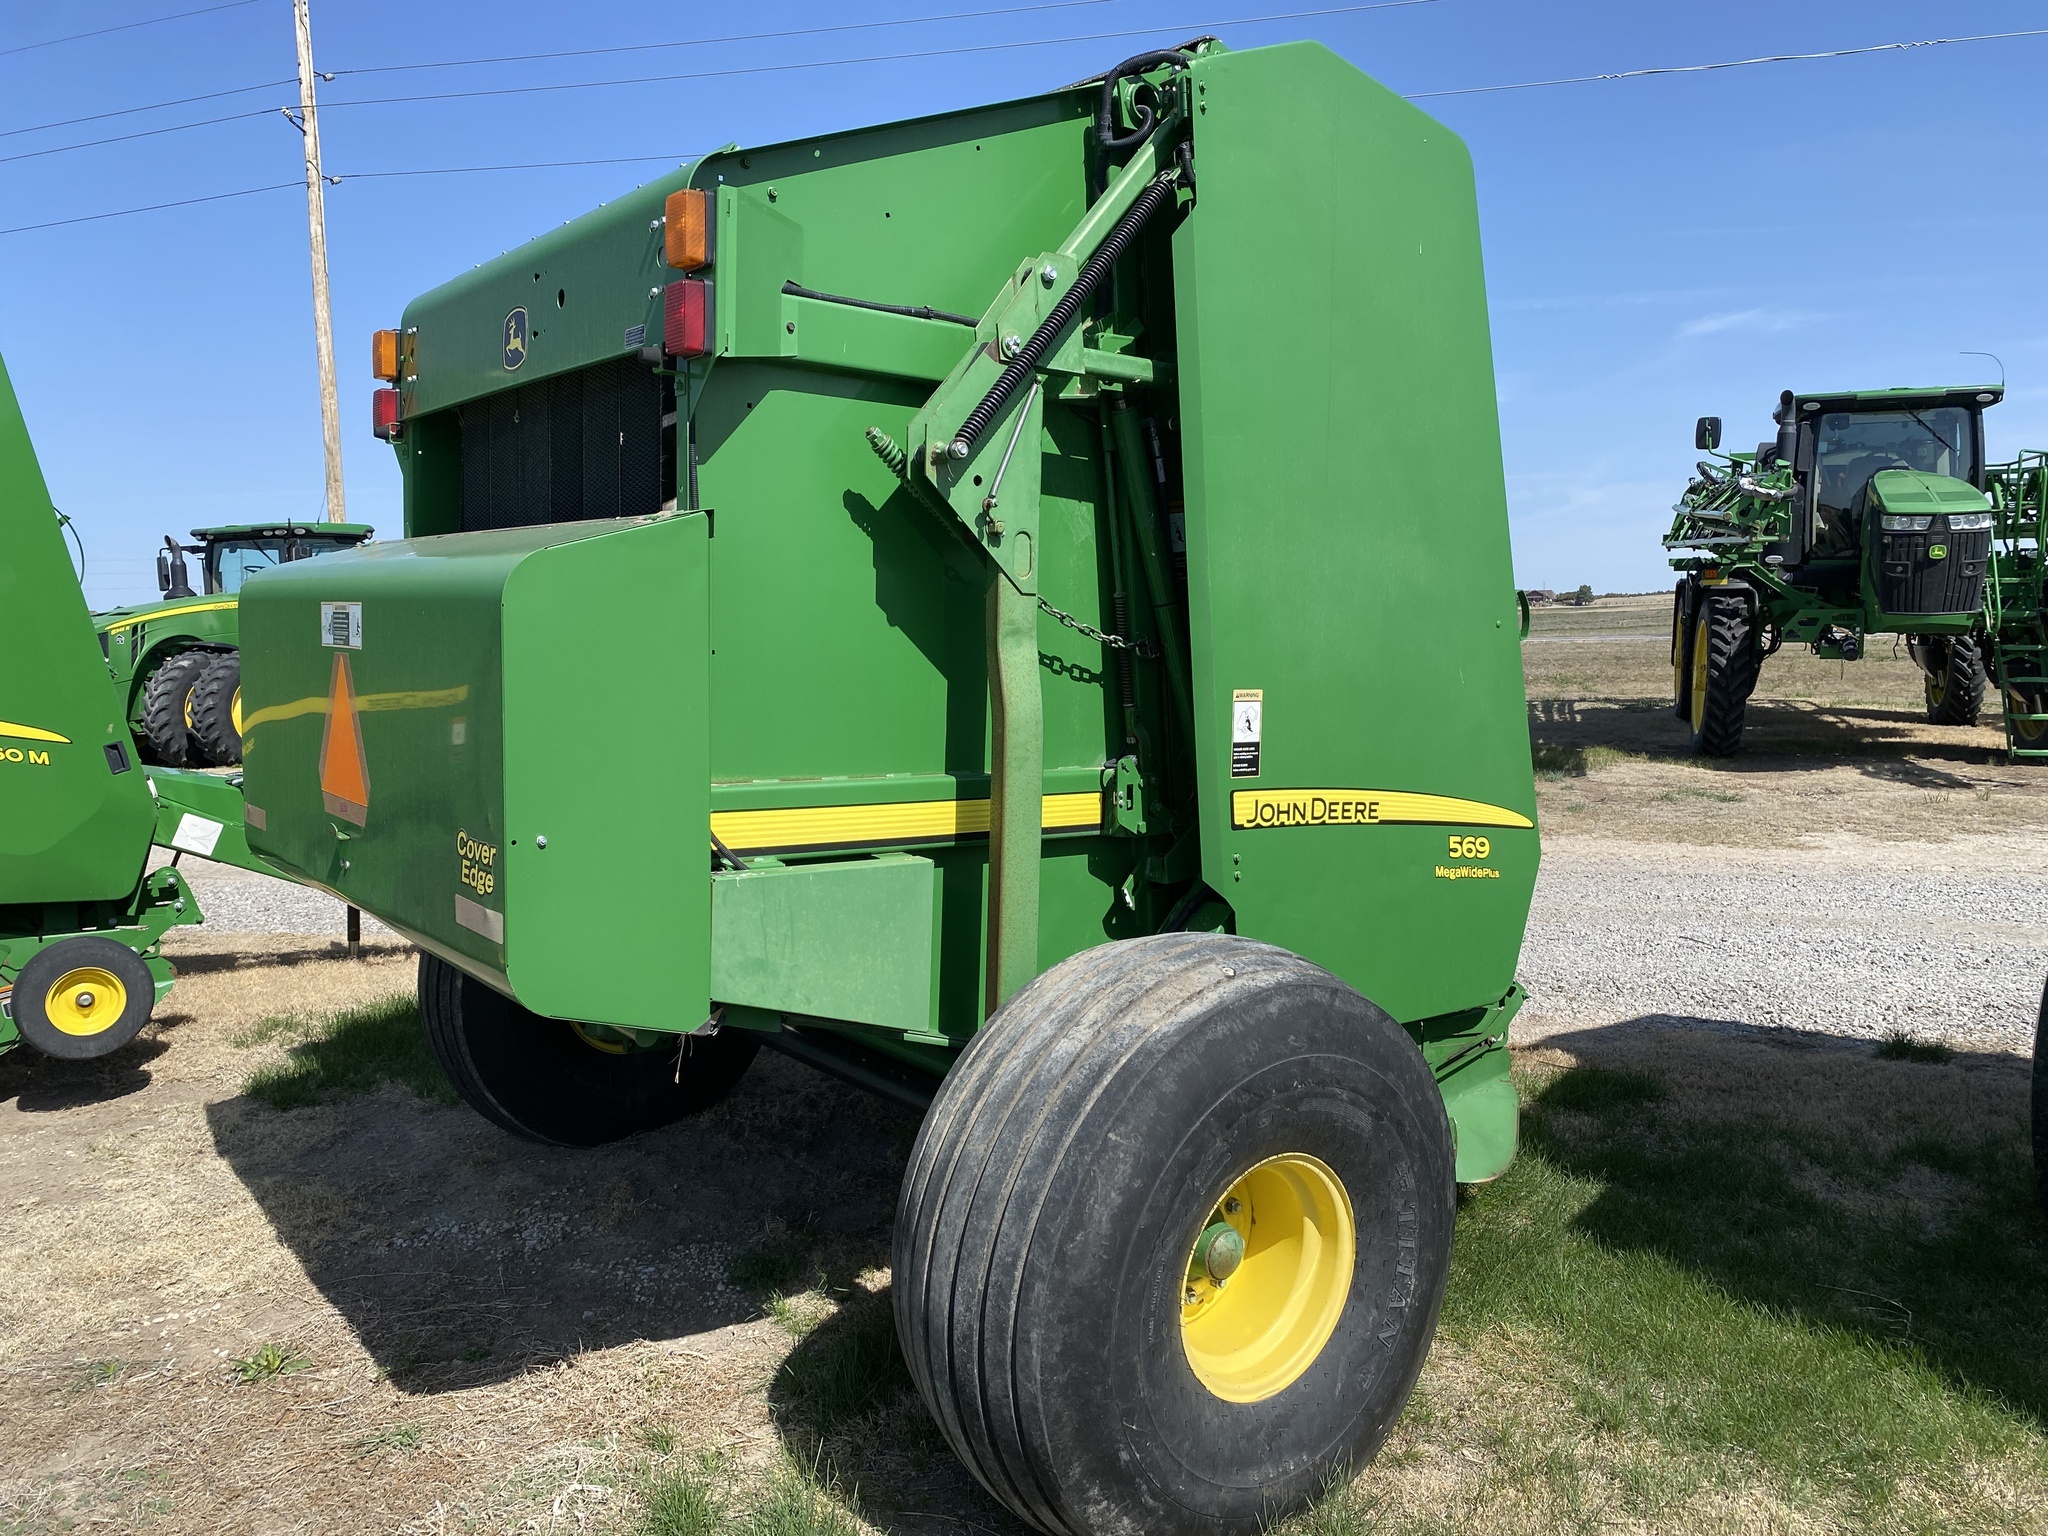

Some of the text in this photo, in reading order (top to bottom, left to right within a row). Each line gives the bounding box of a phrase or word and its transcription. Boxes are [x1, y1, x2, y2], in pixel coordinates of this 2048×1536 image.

[27, 749, 51, 766] M
[1246, 797, 1380, 824] JOHN DEERE
[457, 830, 497, 866] Cover
[1448, 835, 1491, 859] 569
[461, 858, 494, 895] Edge
[1434, 865, 1500, 880] MegaWidePlus
[1376, 1203, 1419, 1352] TITAN
